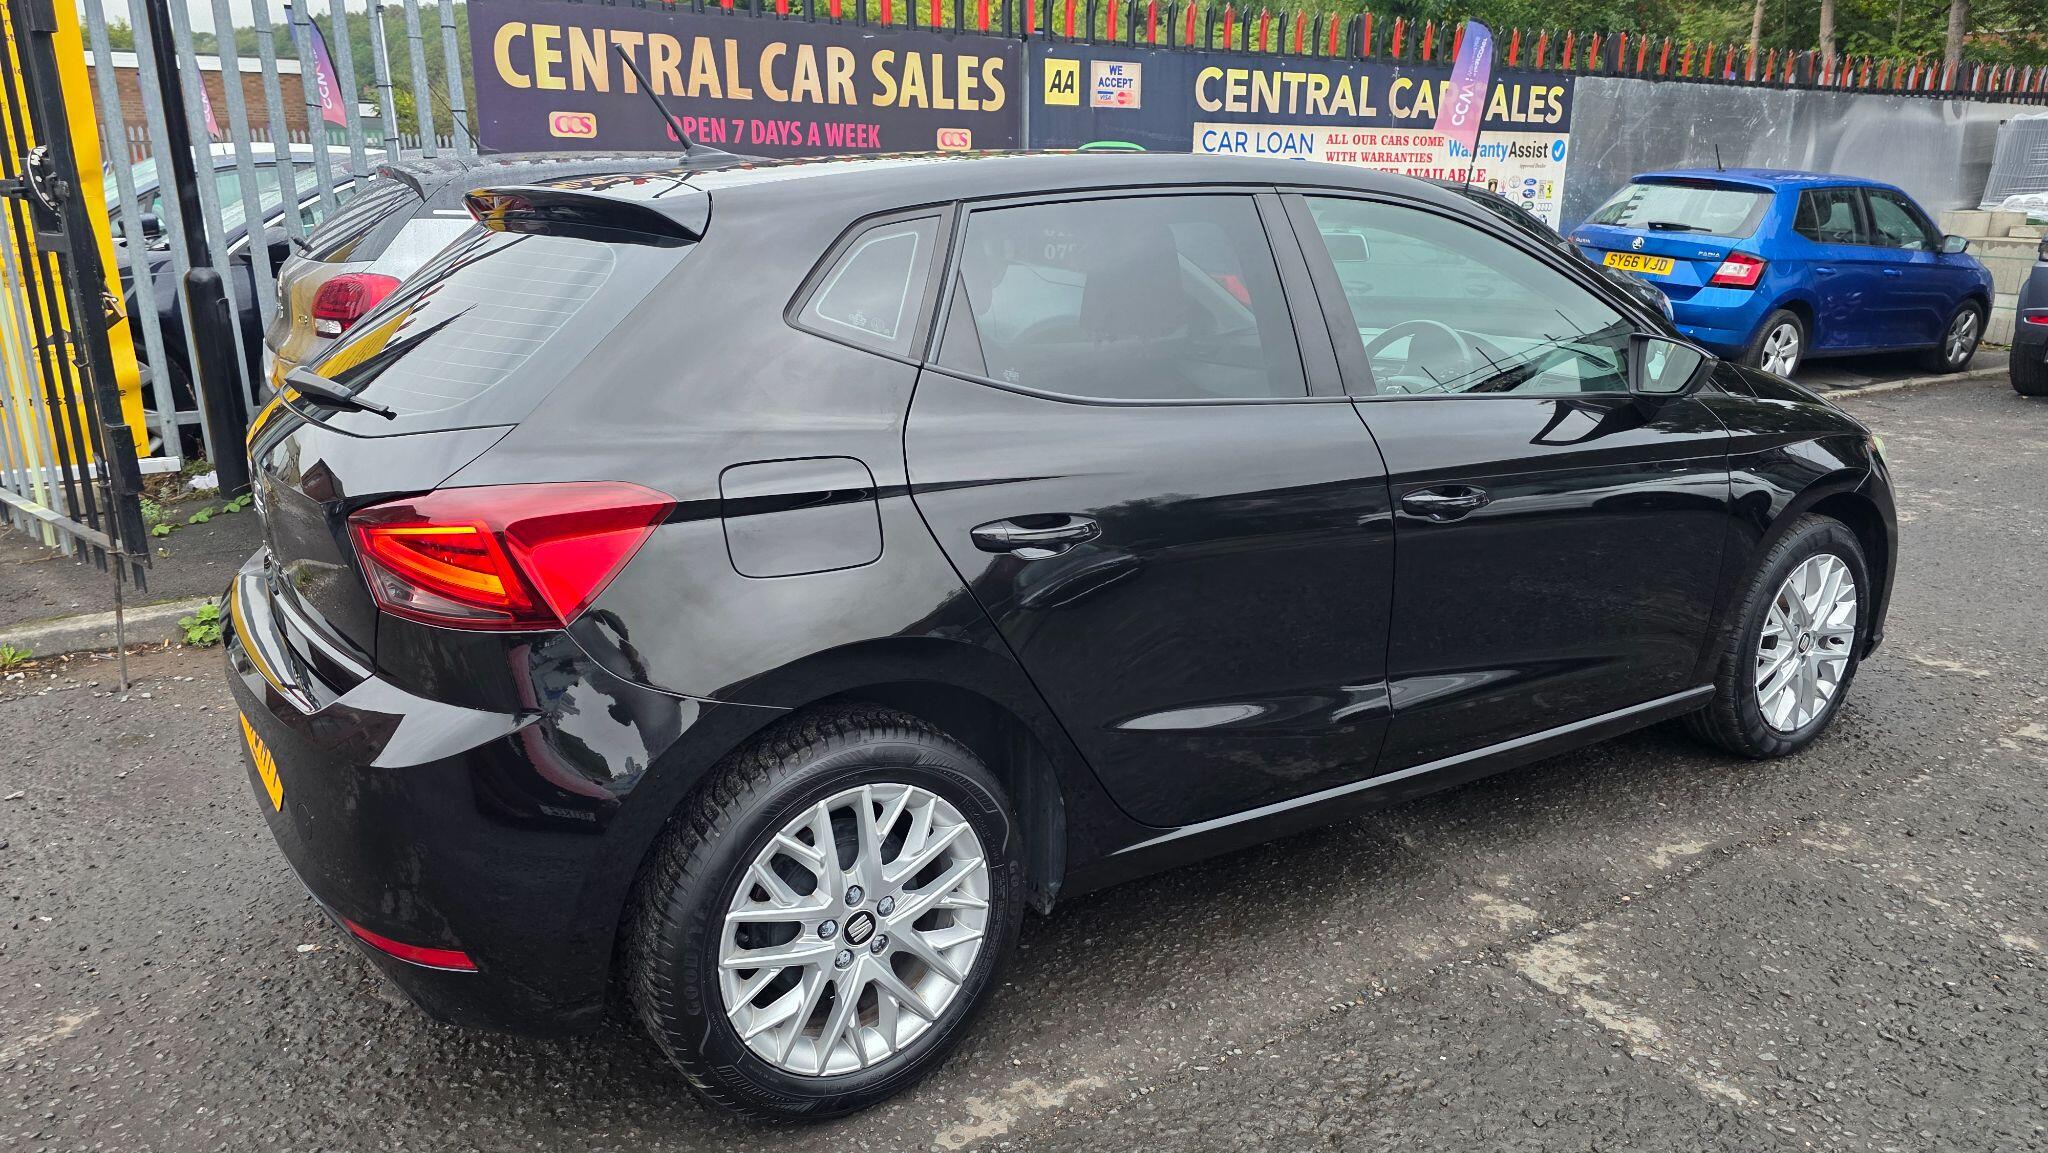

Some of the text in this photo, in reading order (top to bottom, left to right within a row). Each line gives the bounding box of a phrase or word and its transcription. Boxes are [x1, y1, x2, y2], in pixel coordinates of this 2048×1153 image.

[494, 22, 1006, 112] CENTRAL CAR SALES
[1109, 65, 1123, 76] WE
[1049, 69, 1075, 94] AA
[1098, 76, 1134, 89] ACCEPT
[1195, 66, 1377, 117] CENTRAL
[1480, 83, 1565, 124] ALES
[666, 115, 881, 149] OPEN 7 DAYS A WEEK
[1325, 133, 1445, 148] ALL OUR CARS COME
[1202, 130, 1314, 154] CAR LOAN
[1325, 151, 1433, 163] WITH WARRANTIES
[1404, 168, 1487, 183] AVAILABLE
[1609, 253, 1668, 272] SY66 VJD
